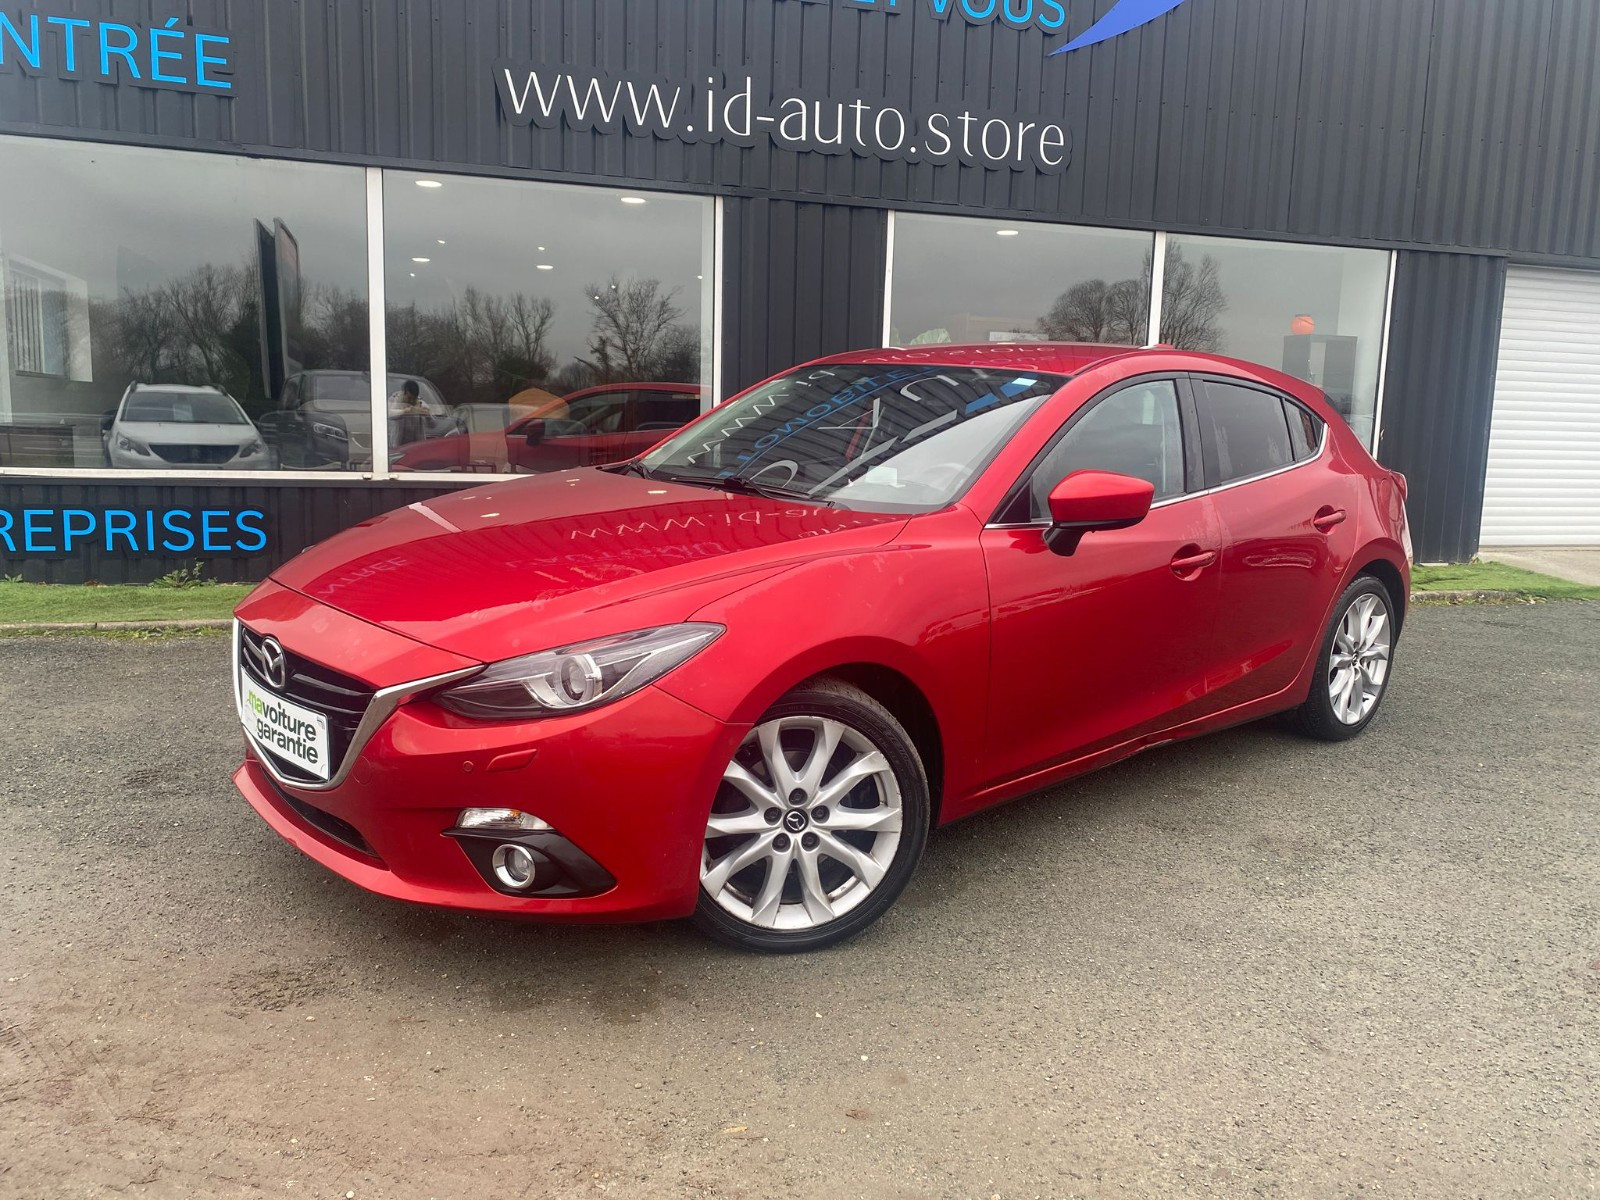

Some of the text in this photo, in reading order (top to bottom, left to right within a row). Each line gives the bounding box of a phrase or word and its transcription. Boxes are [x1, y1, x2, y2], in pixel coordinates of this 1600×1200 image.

[0, 12, 233, 90] NTRÉE
[503, 67, 1065, 168] www.id-auto.store
[248, 690, 317, 742] mavoiture
[256, 718, 319, 764] garantie
